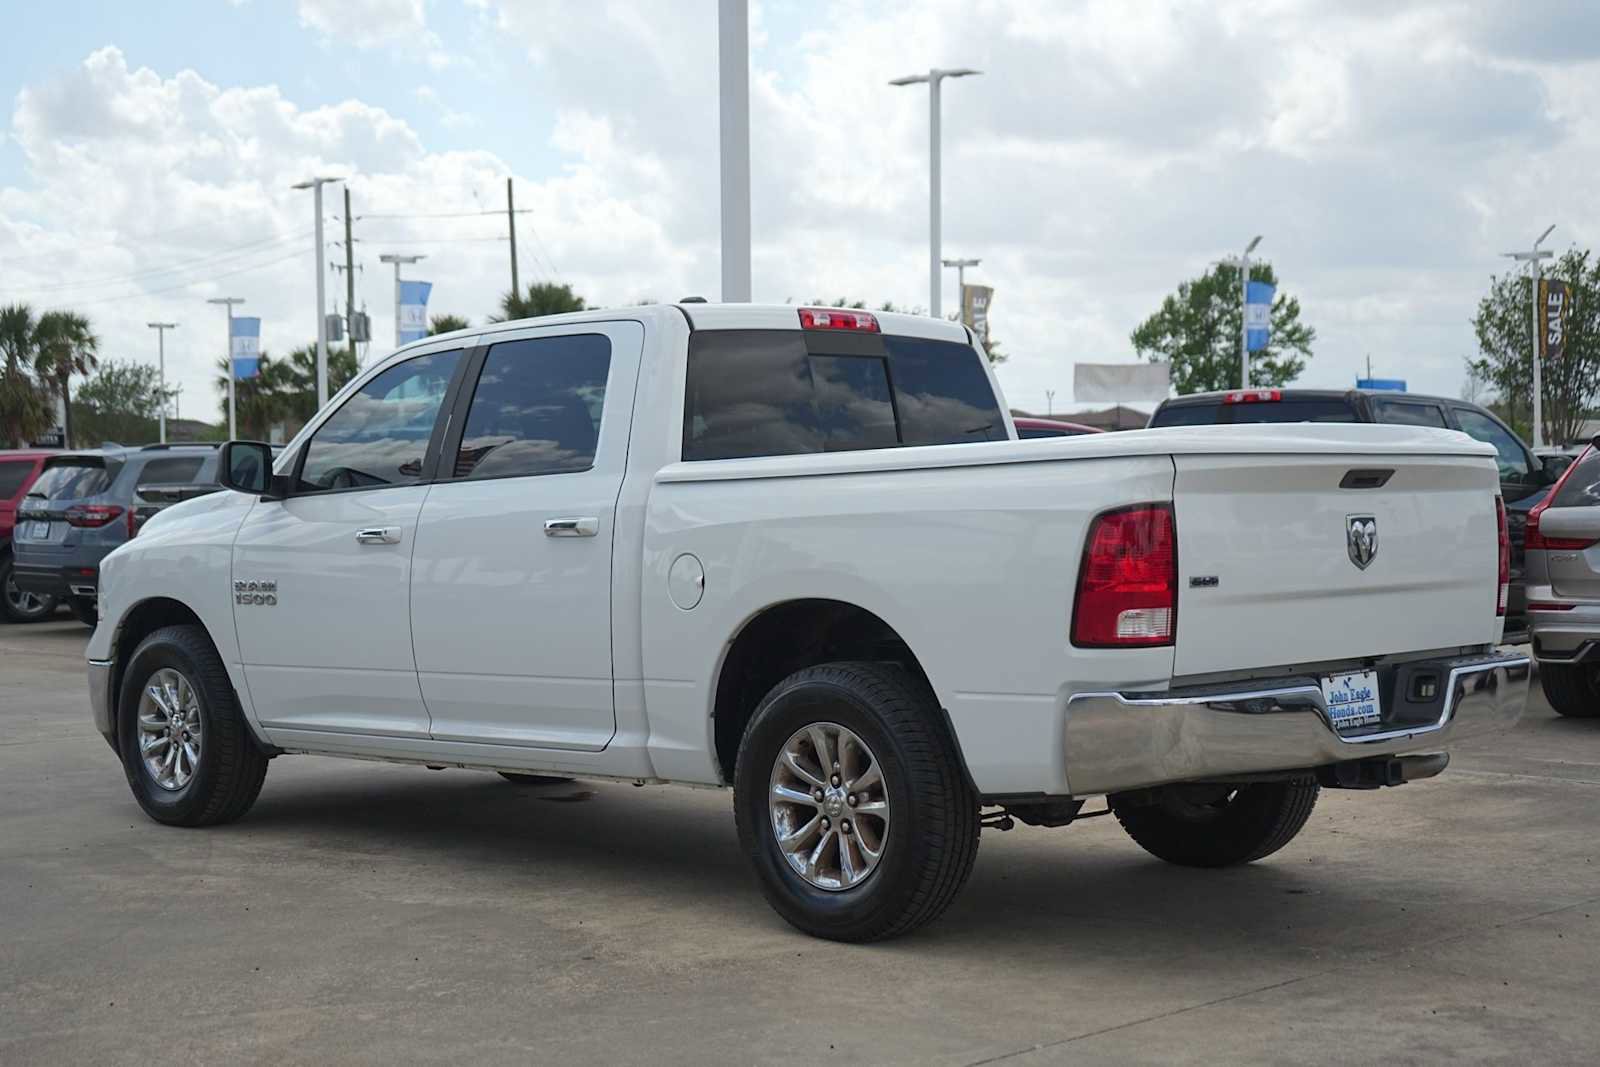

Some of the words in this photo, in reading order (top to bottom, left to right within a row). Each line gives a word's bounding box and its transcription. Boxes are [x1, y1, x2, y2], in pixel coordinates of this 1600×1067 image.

[1548, 292, 1564, 345] SALE
[234, 580, 277, 591] RAM
[236, 593, 277, 605] 1500
[1329, 690, 1349, 704] John
[1350, 686, 1372, 703] Eagle
